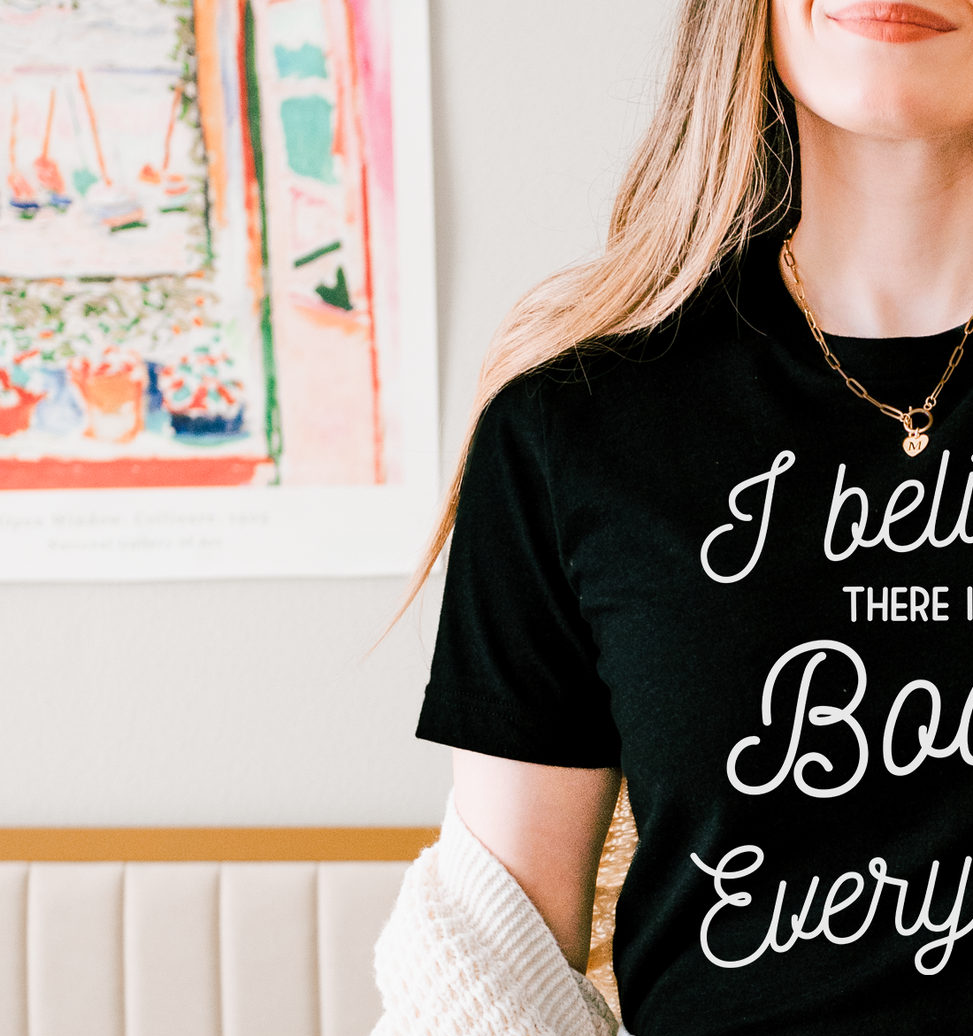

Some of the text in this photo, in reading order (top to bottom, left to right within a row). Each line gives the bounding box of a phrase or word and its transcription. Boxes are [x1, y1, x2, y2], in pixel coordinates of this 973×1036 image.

[907, 441, 922, 451] M
[700, 450, 796, 584] I
[842, 585, 950, 622] THERE
